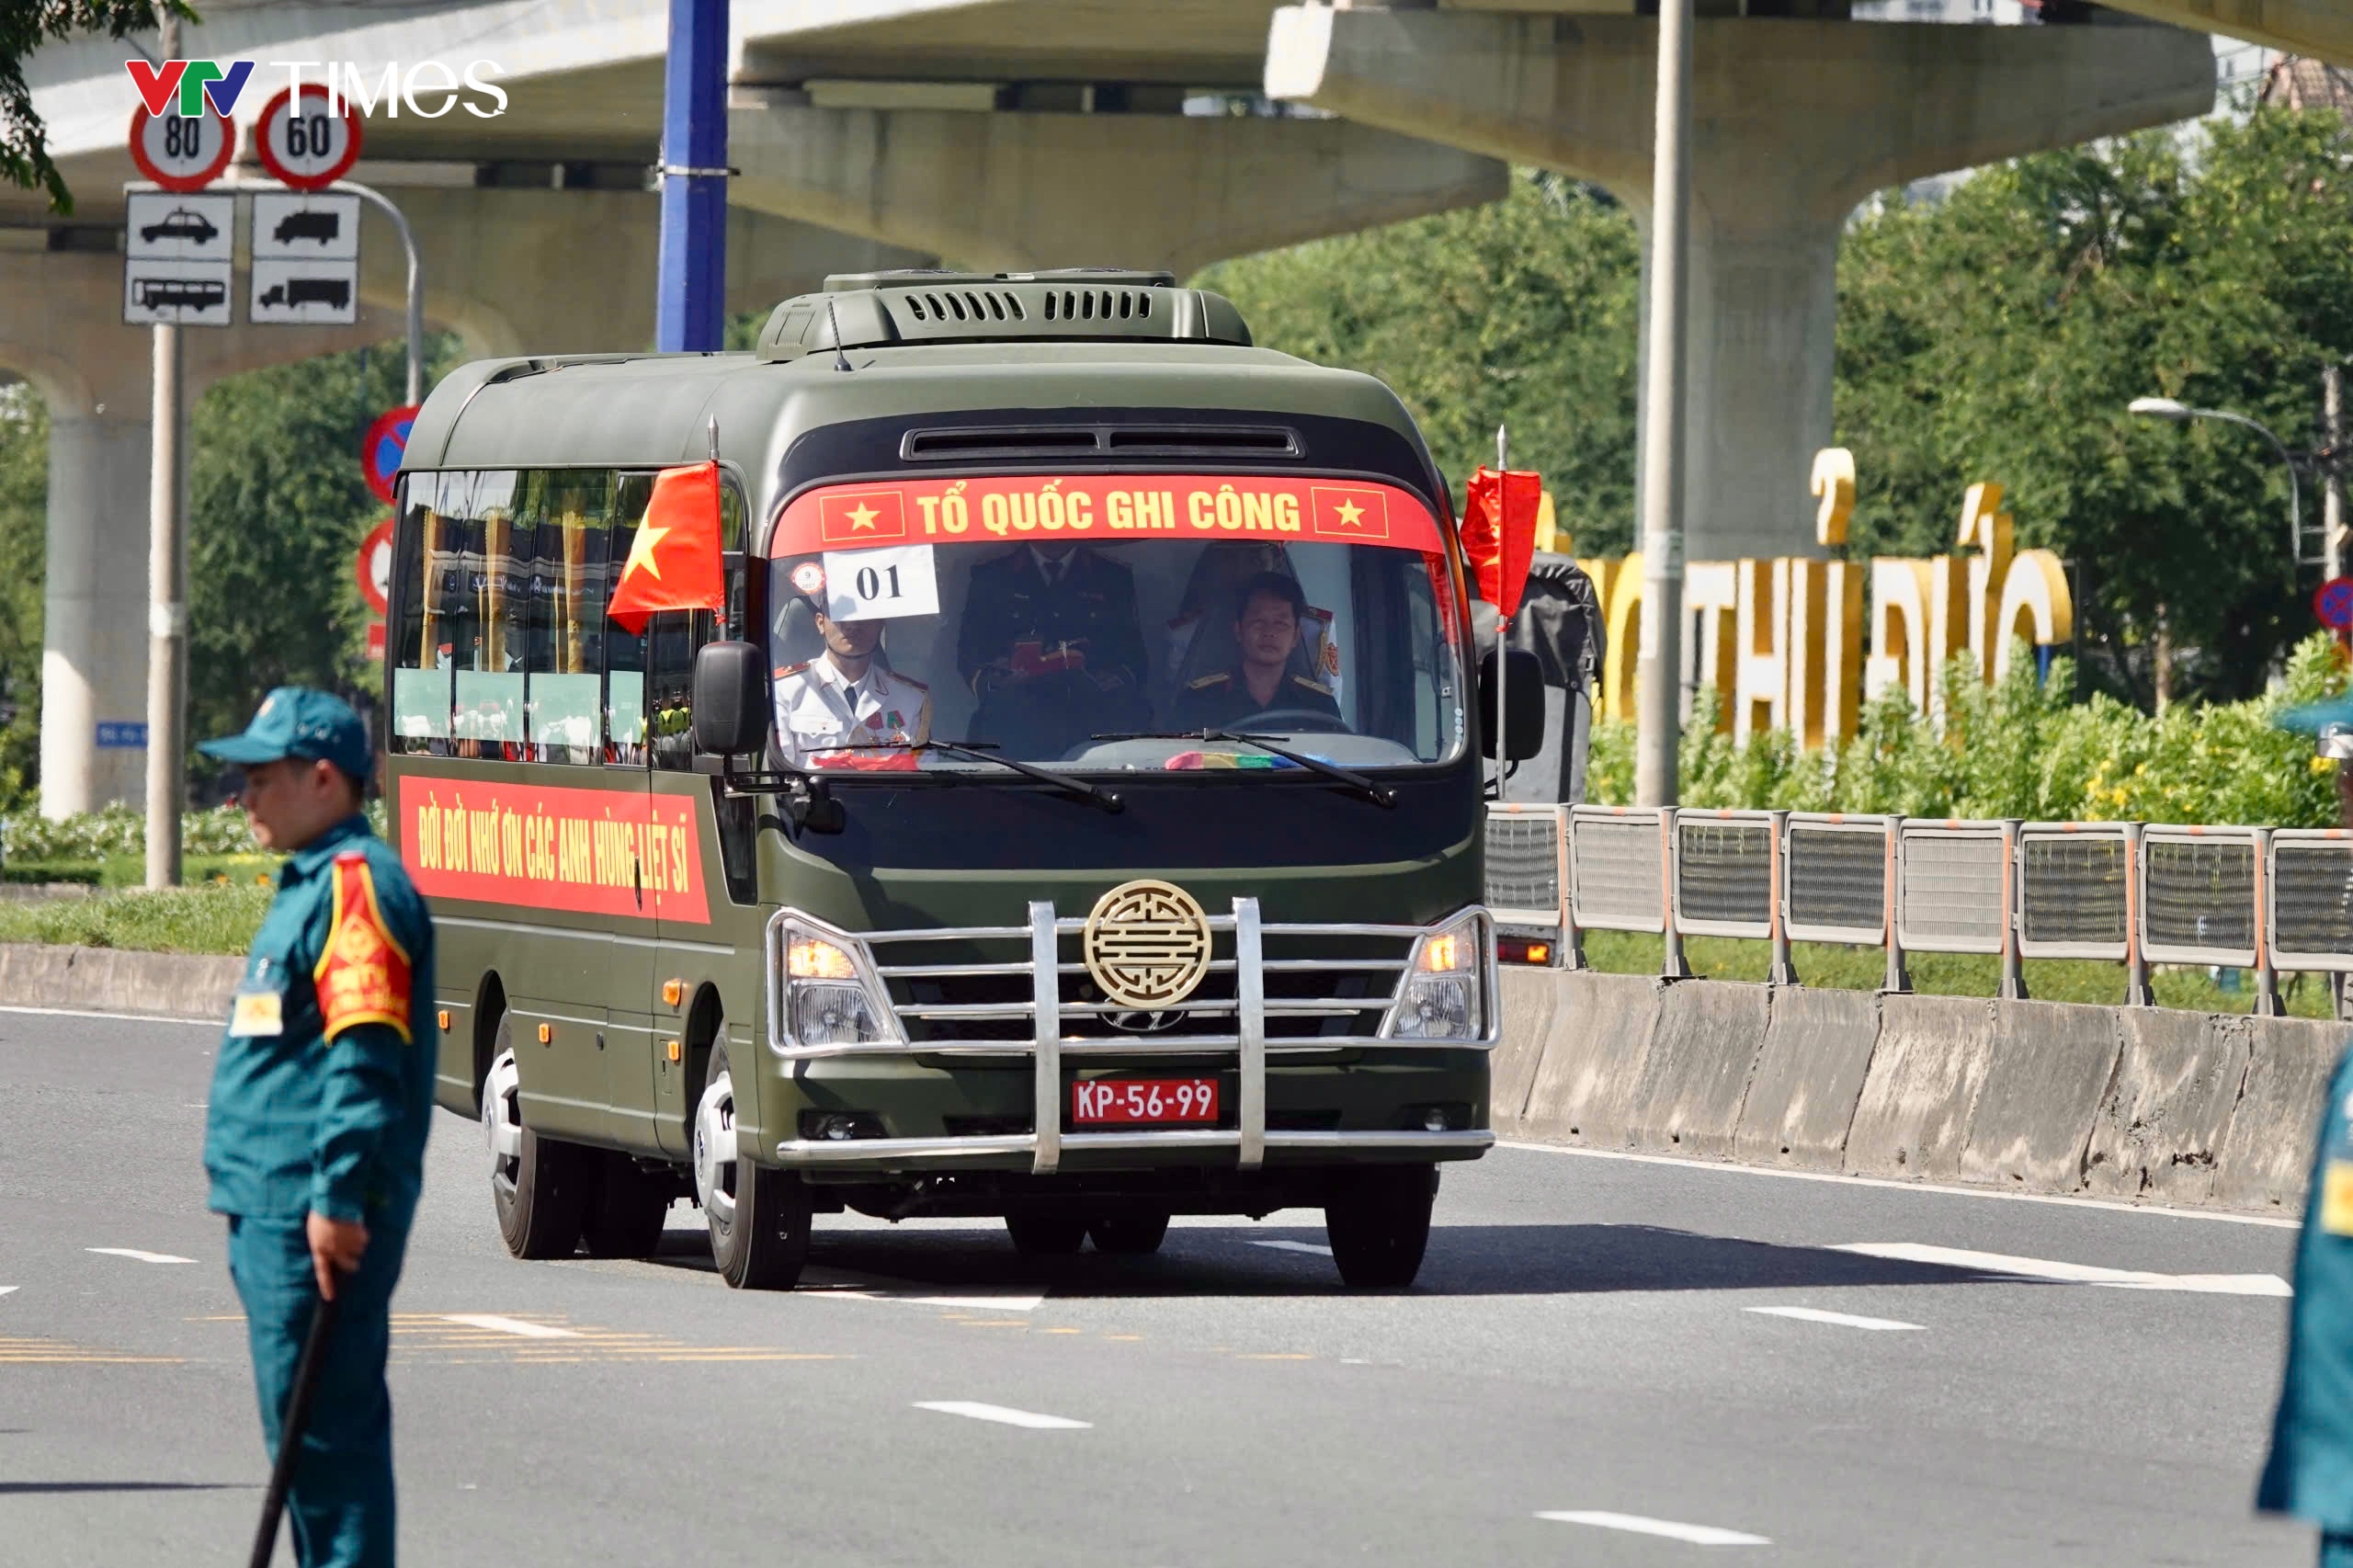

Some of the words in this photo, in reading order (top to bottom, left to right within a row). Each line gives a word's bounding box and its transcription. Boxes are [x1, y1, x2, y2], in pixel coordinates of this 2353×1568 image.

[165, 114, 200, 159] 80
[286, 114, 331, 157] 60
[917, 480, 969, 534] TỔ
[982, 478, 1094, 536] QUỐC
[1106, 490, 1176, 529] GHI
[1188, 483, 1302, 532] CÔNG
[856, 563, 904, 601] 01
[418, 790, 442, 869] ĐỜI
[444, 793, 469, 872] ĐỜI
[471, 798, 501, 876] NHỚ
[502, 806, 524, 879] ƠN
[525, 801, 555, 881] CÁC
[559, 817, 592, 884] ANH
[593, 806, 636, 889] HÙNG
[637, 810, 669, 905] LIỆT
[671, 812, 688, 892] SĨ
[1078, 1085, 1212, 1119] KP-56-99
